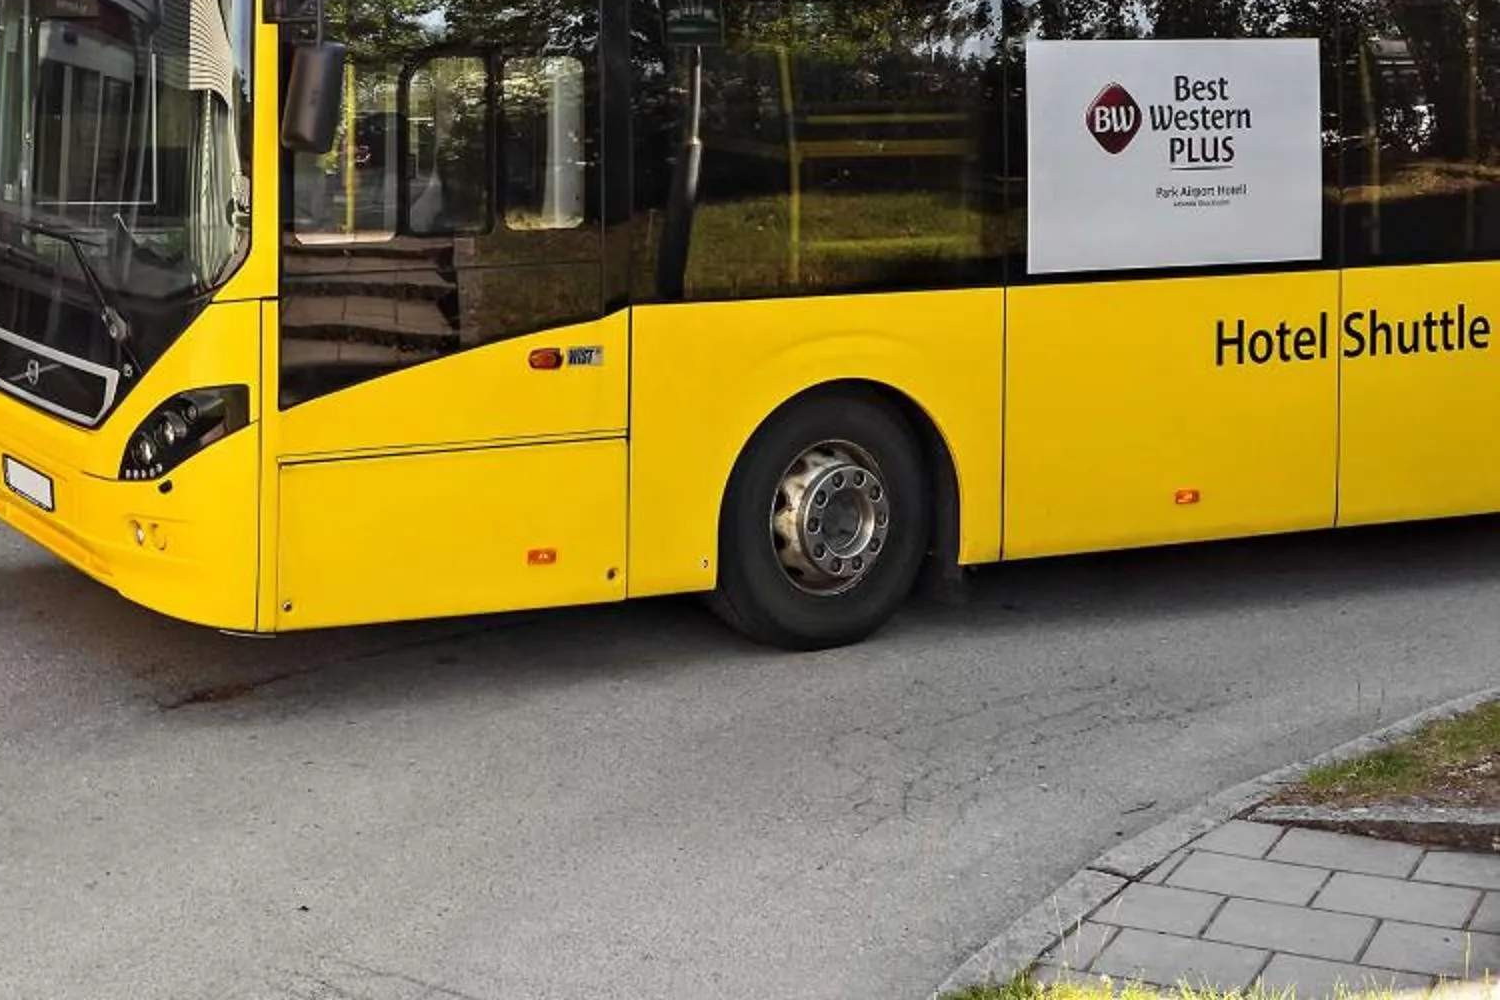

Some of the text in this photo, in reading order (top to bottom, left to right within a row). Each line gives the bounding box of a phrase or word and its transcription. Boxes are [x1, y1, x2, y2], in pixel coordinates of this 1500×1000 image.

[1174, 75, 1229, 102] Best
[1094, 105, 1135, 133] BW
[1149, 105, 1252, 131] Western
[1169, 135, 1236, 164] PLUS
[1215, 303, 1491, 367] Hotel Shuttle
